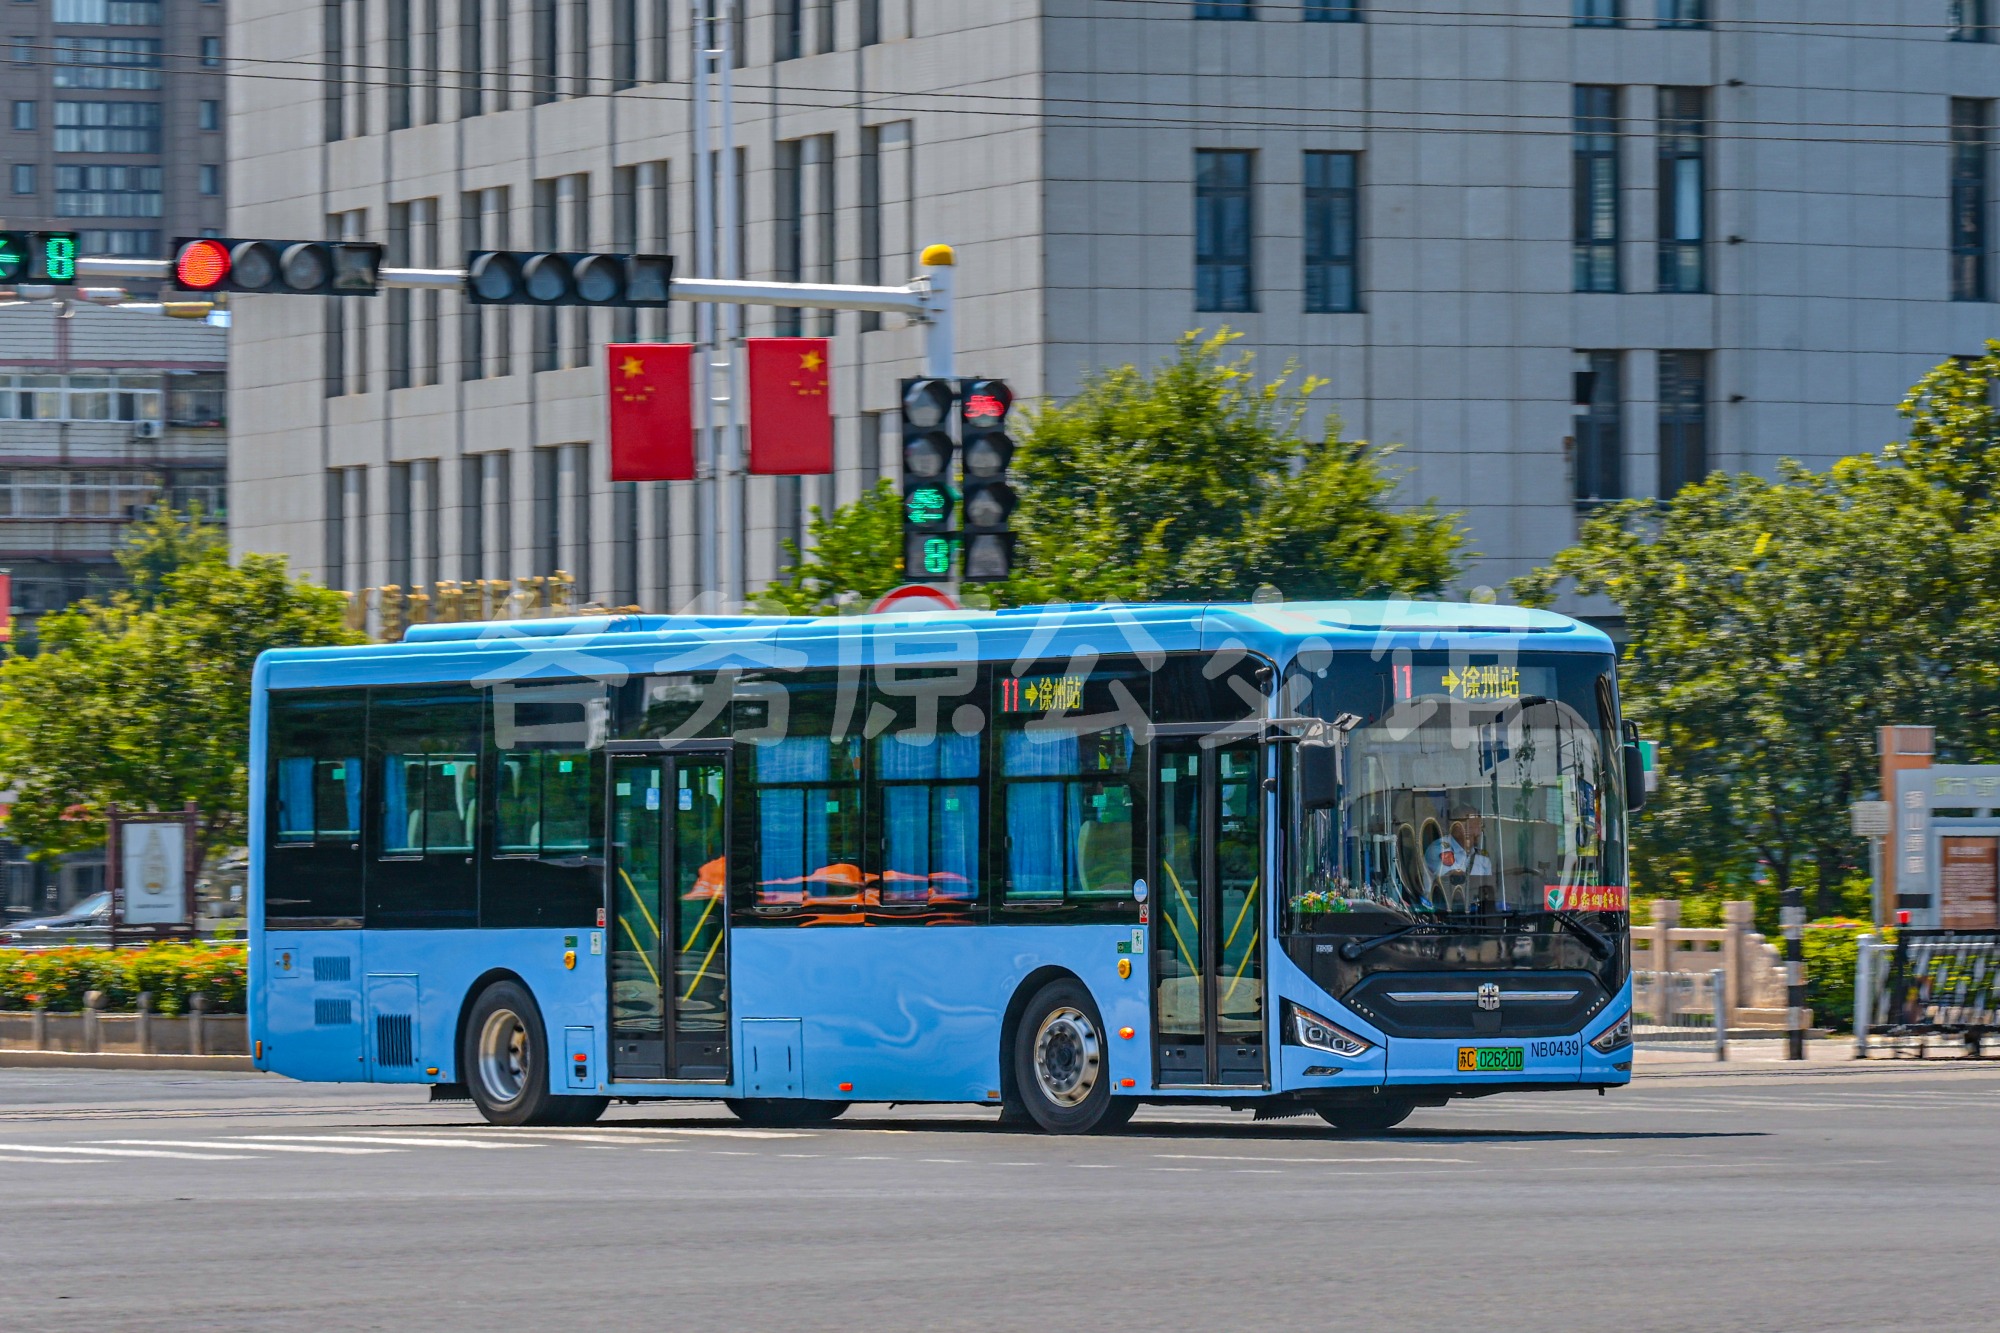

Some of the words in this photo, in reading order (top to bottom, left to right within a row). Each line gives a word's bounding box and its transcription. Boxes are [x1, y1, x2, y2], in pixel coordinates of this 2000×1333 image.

[46, 238, 75, 278] 8
[924, 538, 949, 573] 8
[1002, 678, 1019, 712] 11
[1039, 676, 1081, 711] 徐州站
[1392, 665, 1412, 699] 11
[1461, 665, 1520, 699] 徐州站
[1531, 1040, 1579, 1058] NB0439
